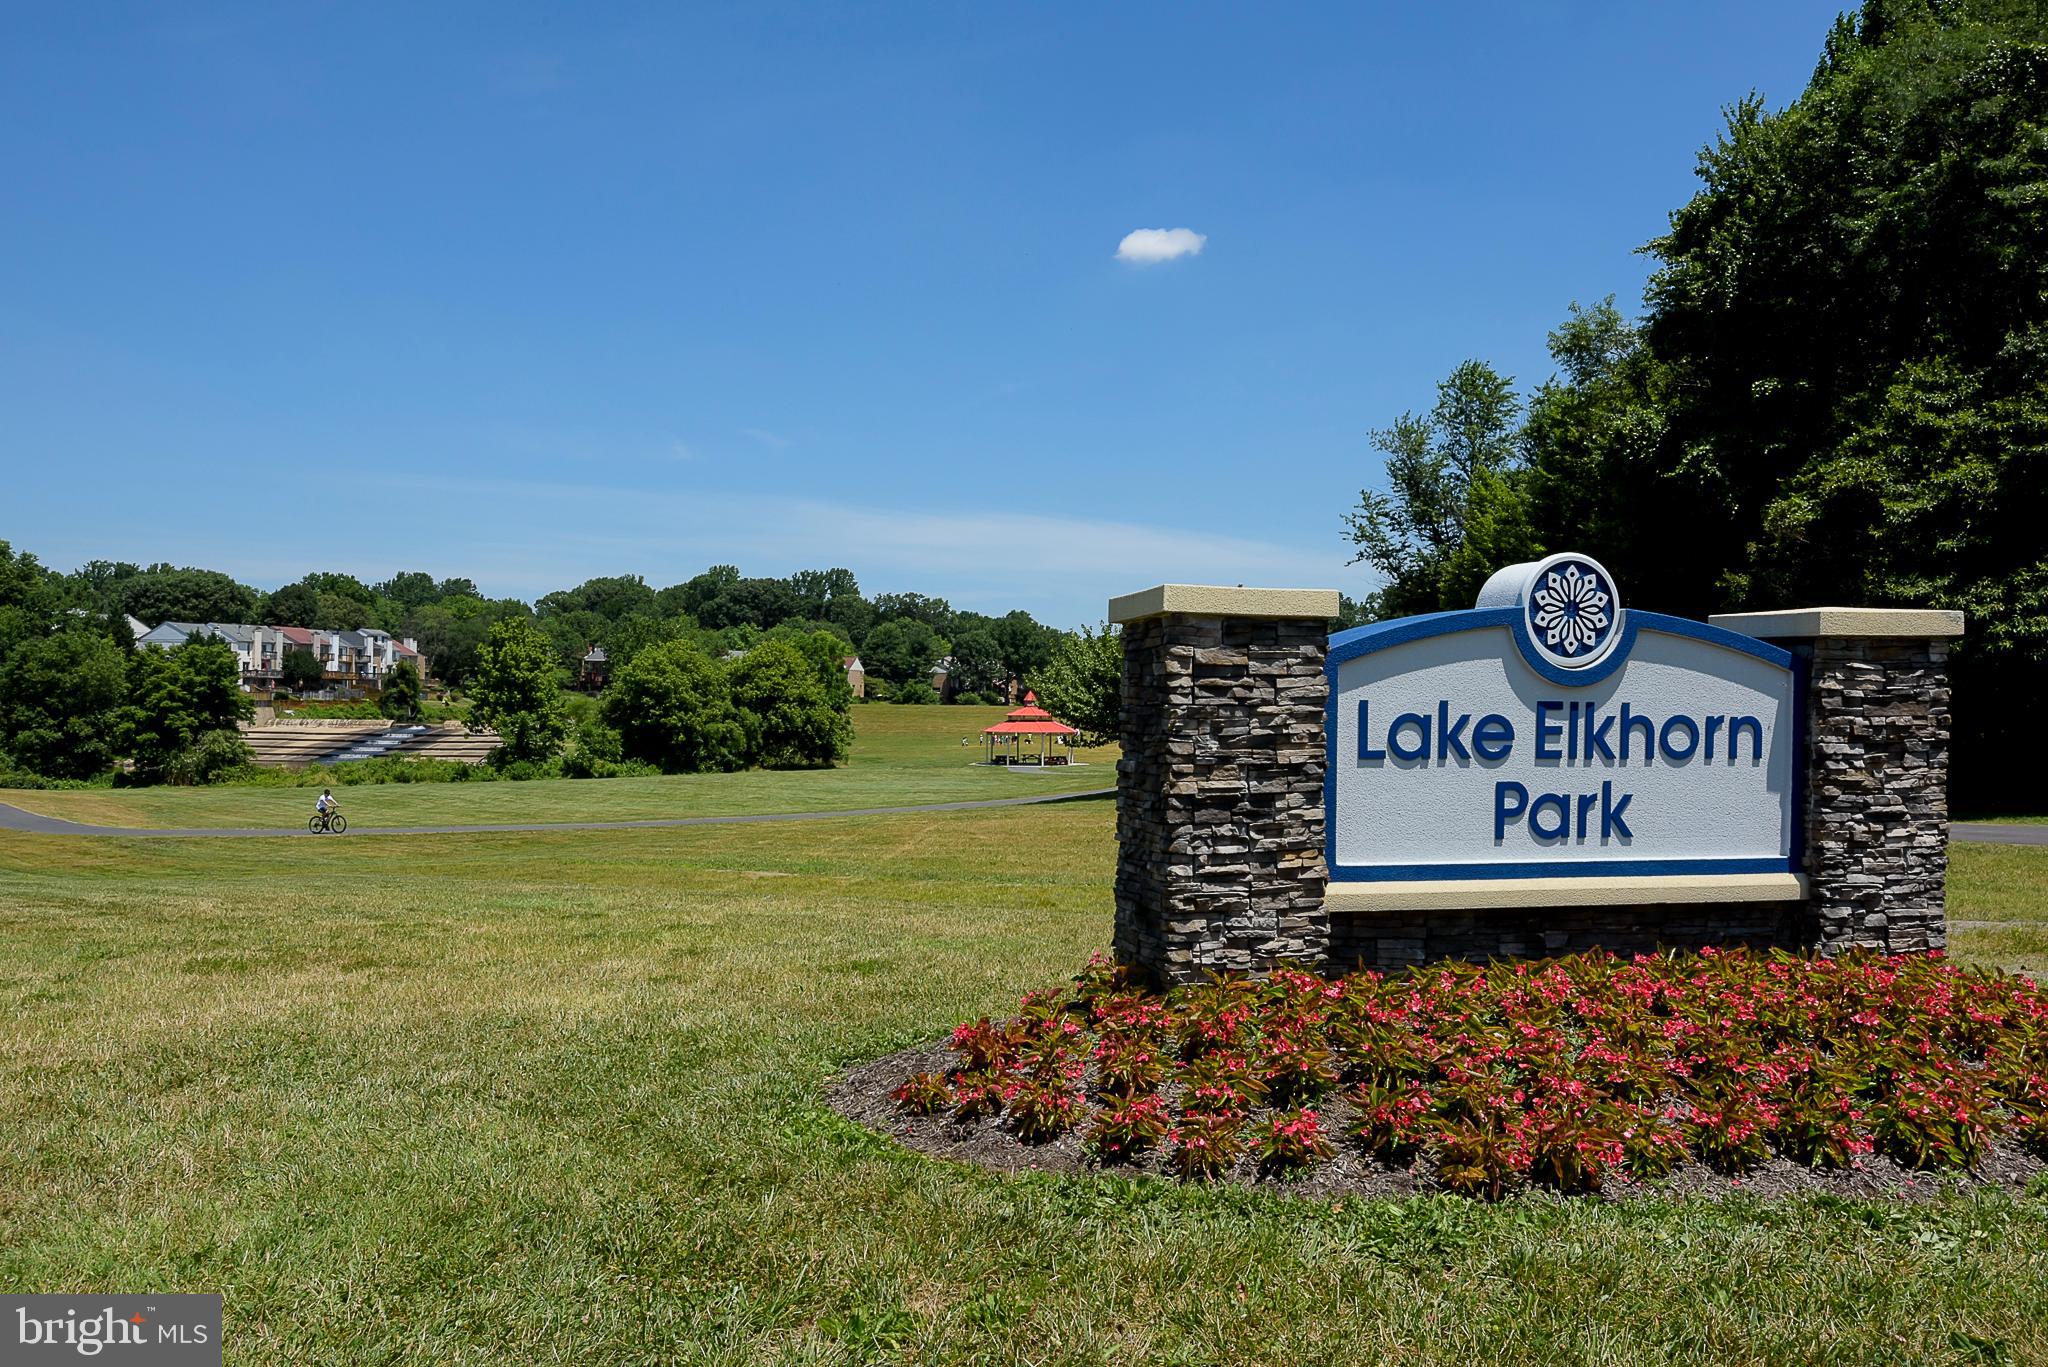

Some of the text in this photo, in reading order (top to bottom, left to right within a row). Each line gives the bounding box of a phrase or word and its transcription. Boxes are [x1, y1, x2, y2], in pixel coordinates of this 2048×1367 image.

[1357, 699, 1763, 761] Lake Elkhorn
[1494, 780, 1634, 841] Park
